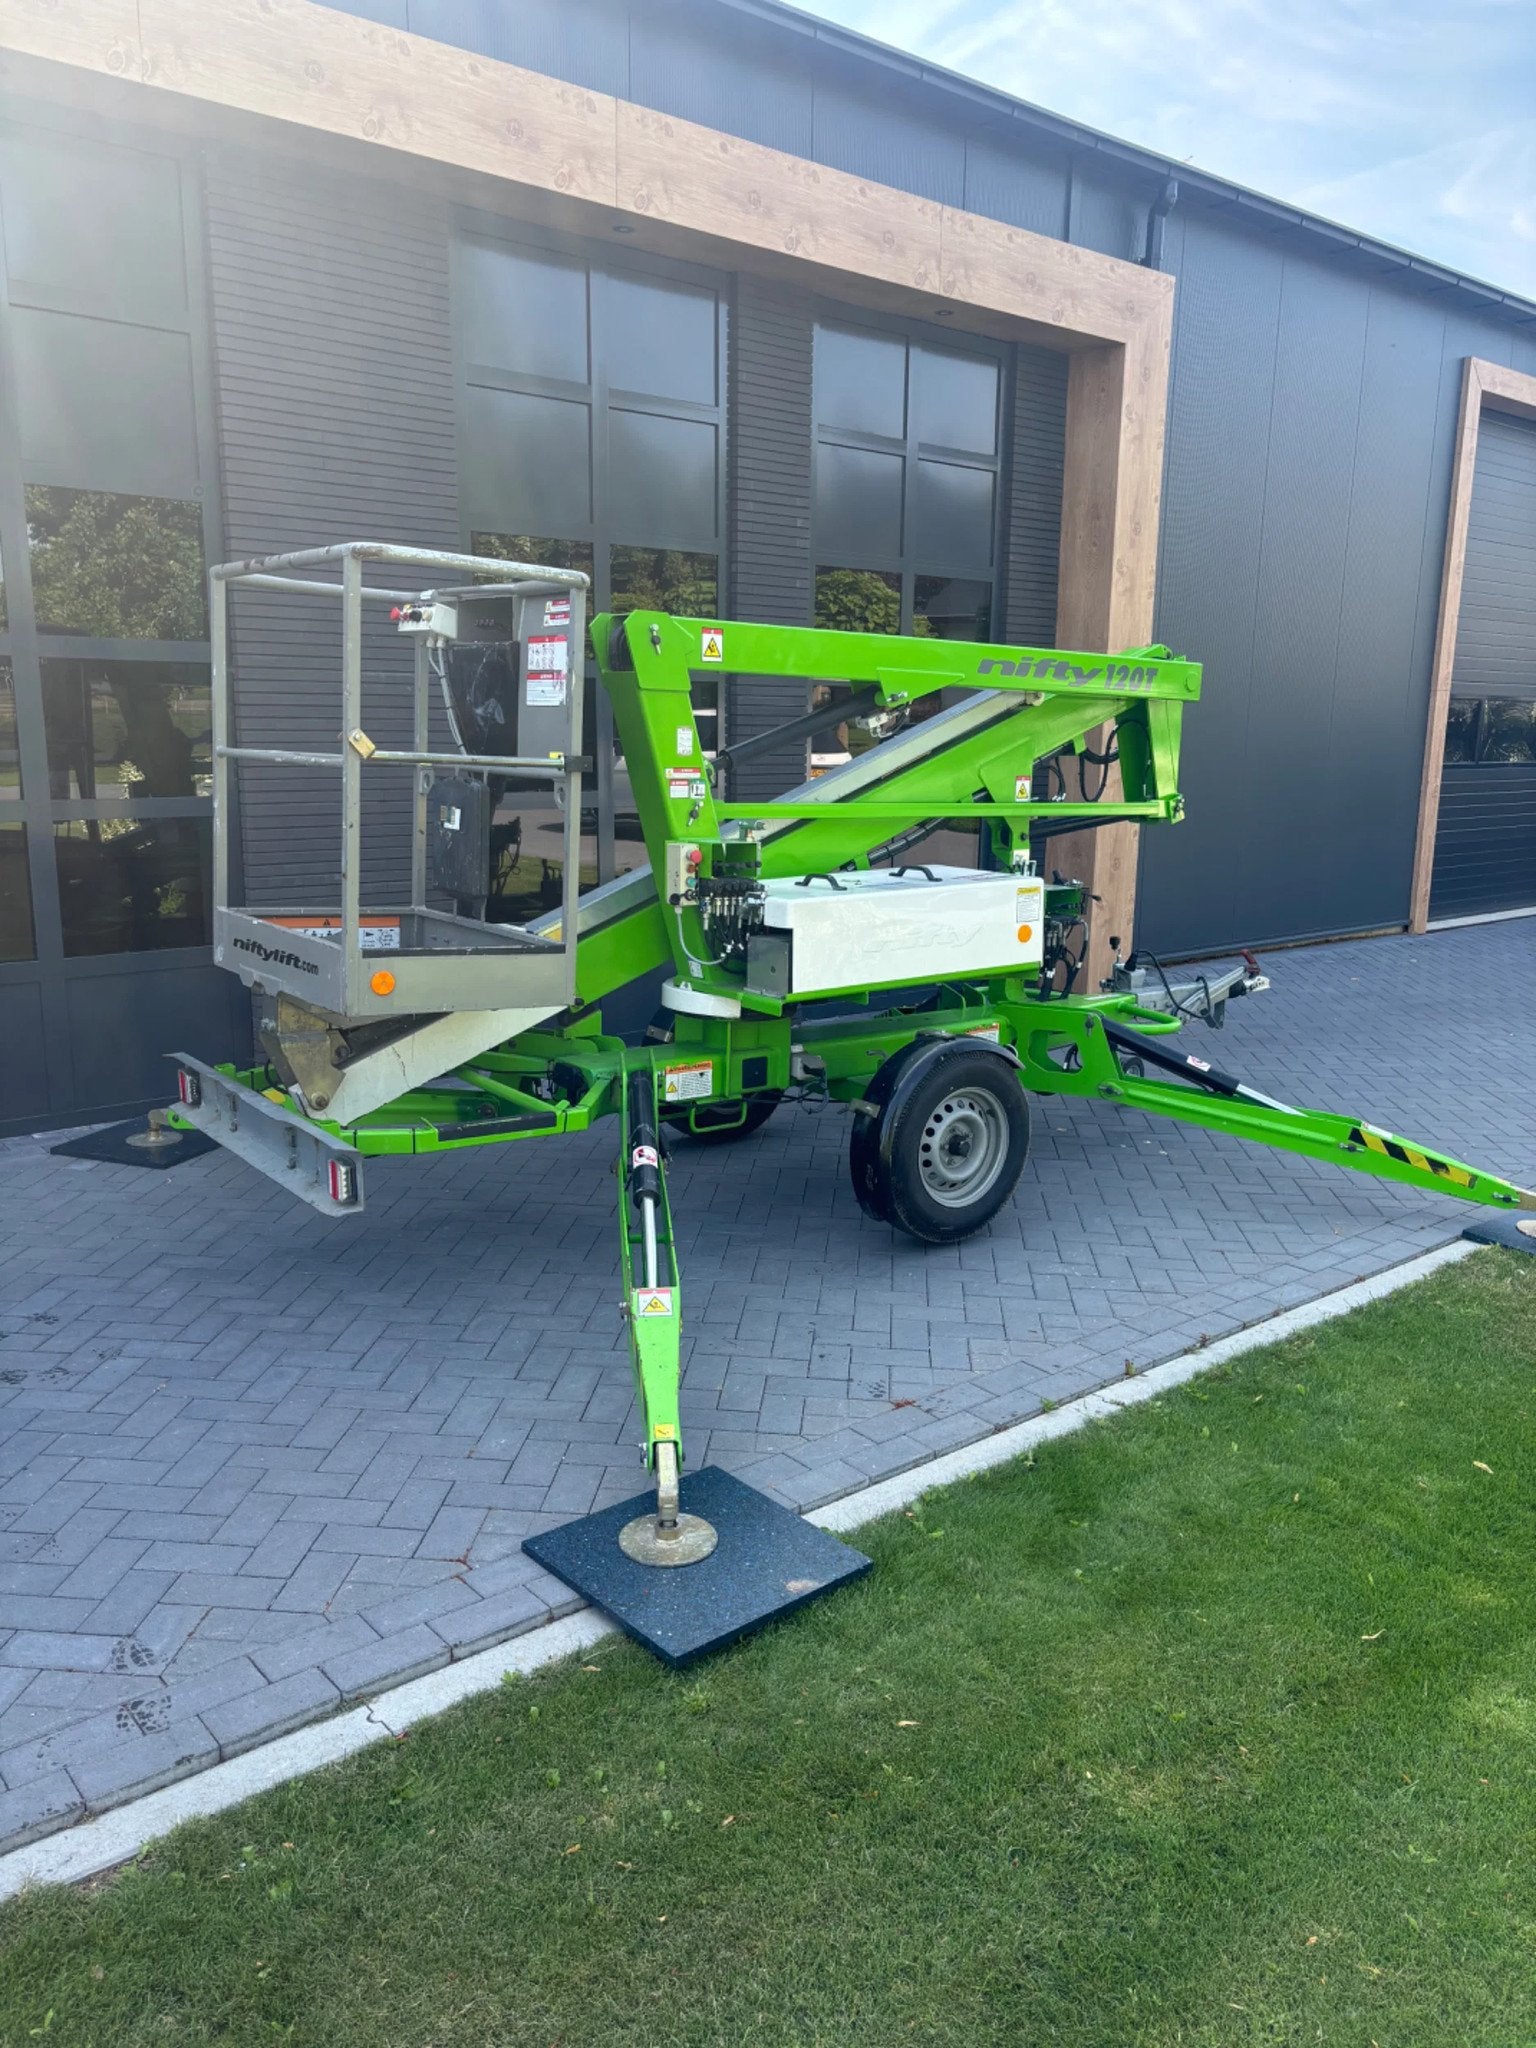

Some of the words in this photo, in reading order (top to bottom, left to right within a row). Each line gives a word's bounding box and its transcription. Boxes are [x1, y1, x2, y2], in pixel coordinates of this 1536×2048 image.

[977, 656, 1103, 687] nifty
[1104, 663, 1158, 692] 120T
[233, 937, 320, 976] niftylift.com
